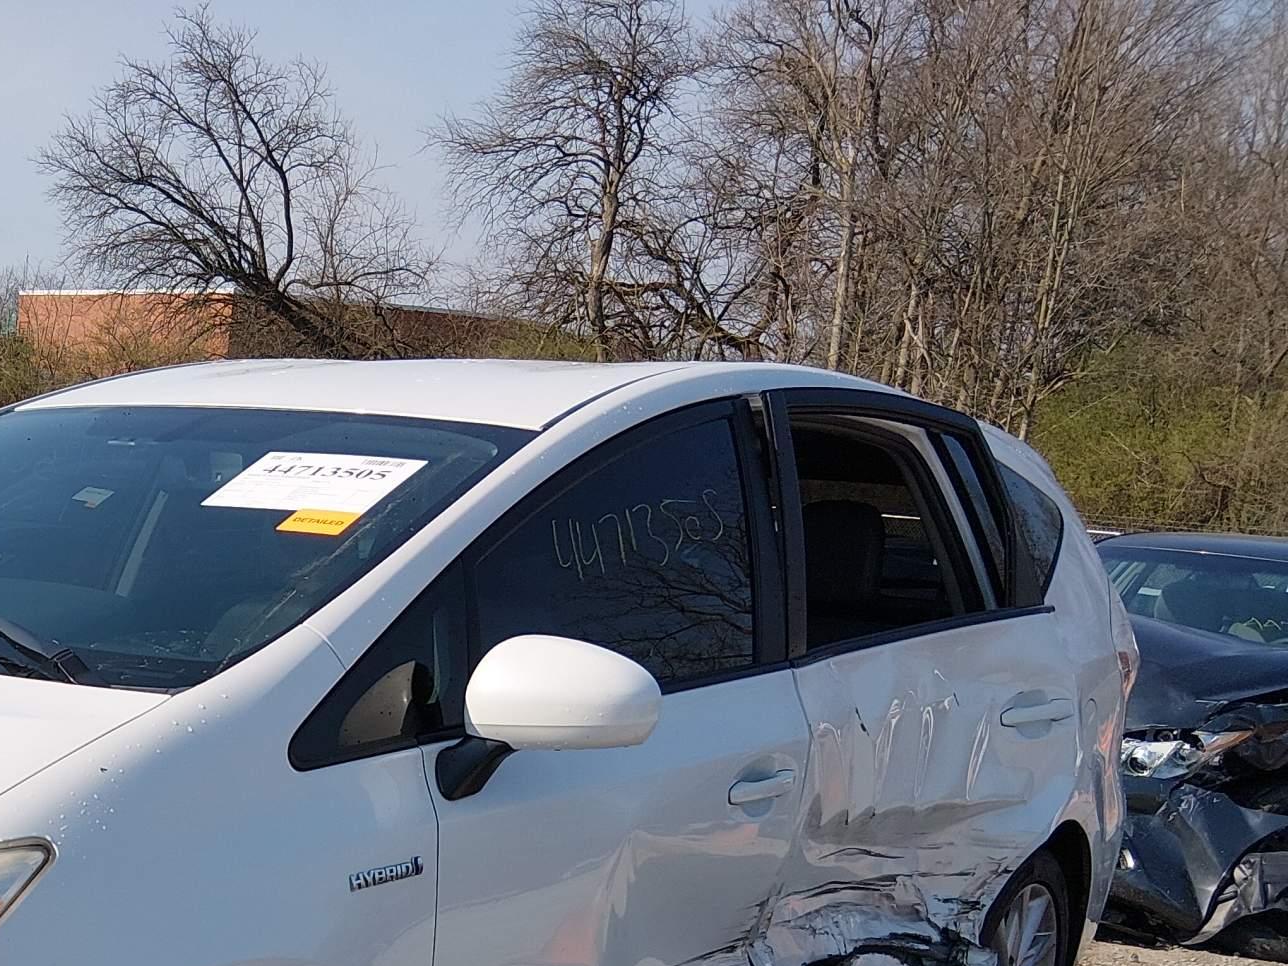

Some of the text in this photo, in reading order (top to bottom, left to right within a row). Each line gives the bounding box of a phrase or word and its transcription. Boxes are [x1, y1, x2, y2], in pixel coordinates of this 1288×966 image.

[262, 463, 393, 481] 44713505
[292, 516, 345, 527] DETAILED
[349, 861, 415, 892] HYBRID
